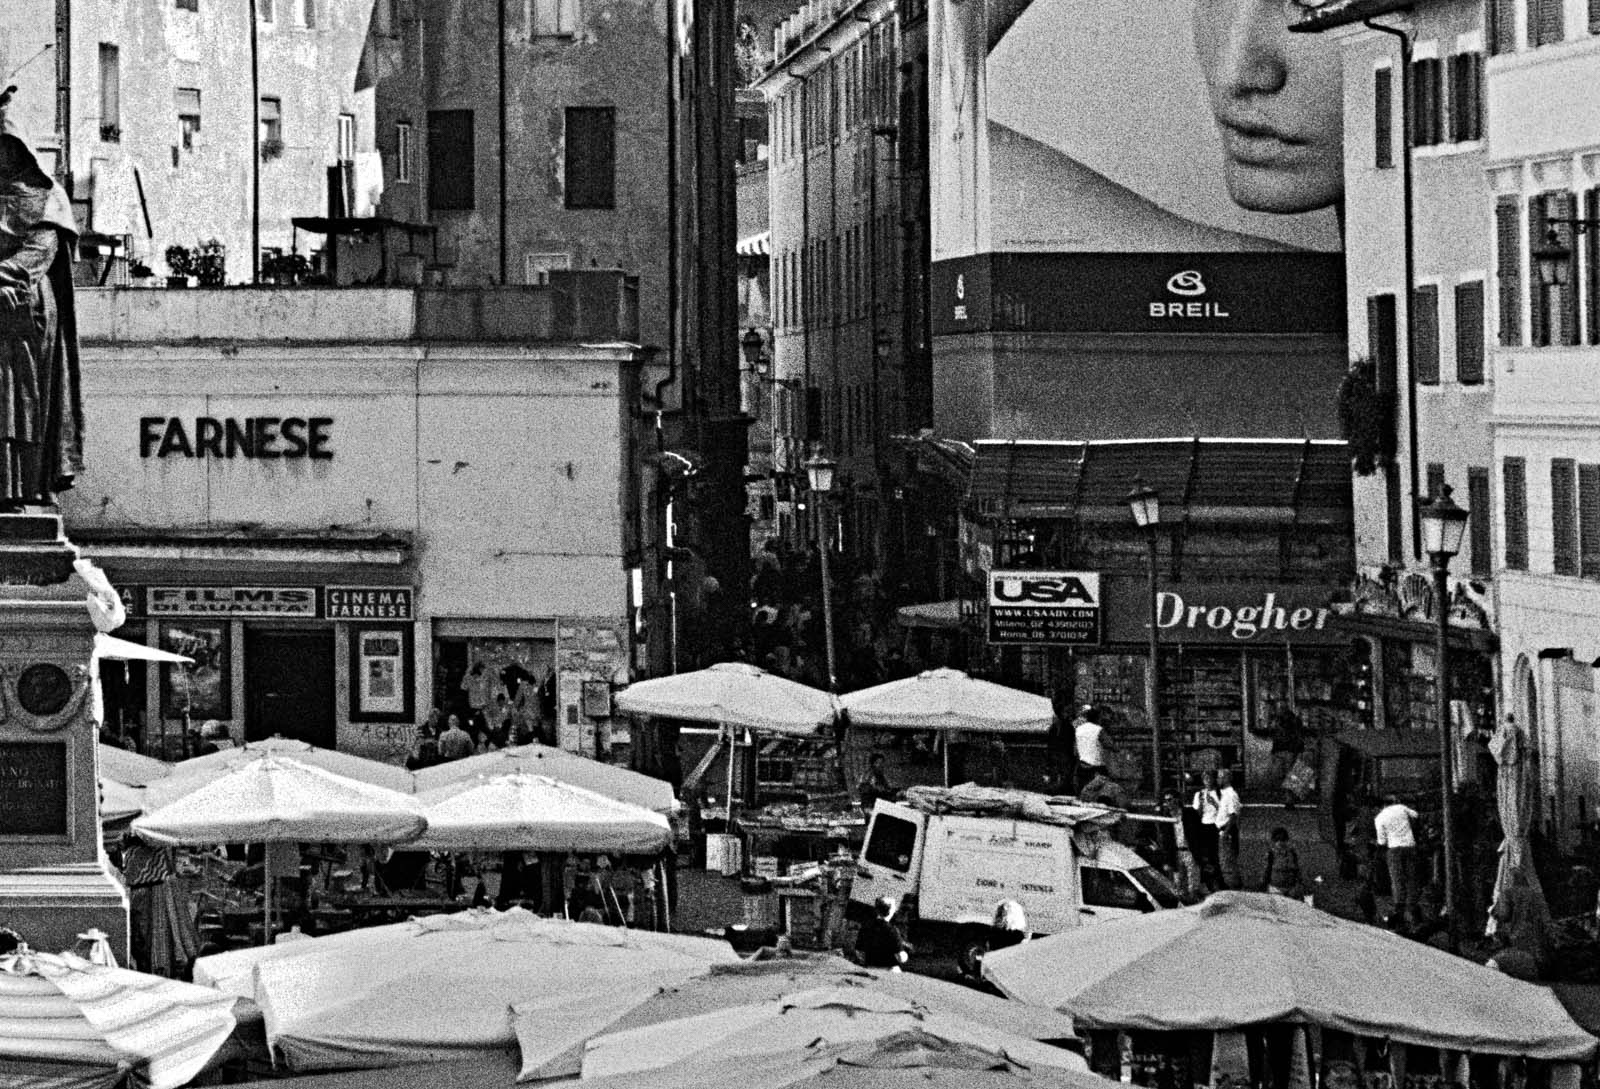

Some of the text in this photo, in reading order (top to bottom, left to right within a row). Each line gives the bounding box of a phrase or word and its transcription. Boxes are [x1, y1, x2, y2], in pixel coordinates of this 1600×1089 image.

[1149, 302, 1230, 318] BREIL
[138, 416, 334, 460] FARNESE
[152, 589, 310, 602] FILMS
[993, 576, 1095, 603] USA
[331, 592, 406, 604] CINEMA
[152, 603, 179, 612] DI
[331, 605, 407, 617] FARNESE
